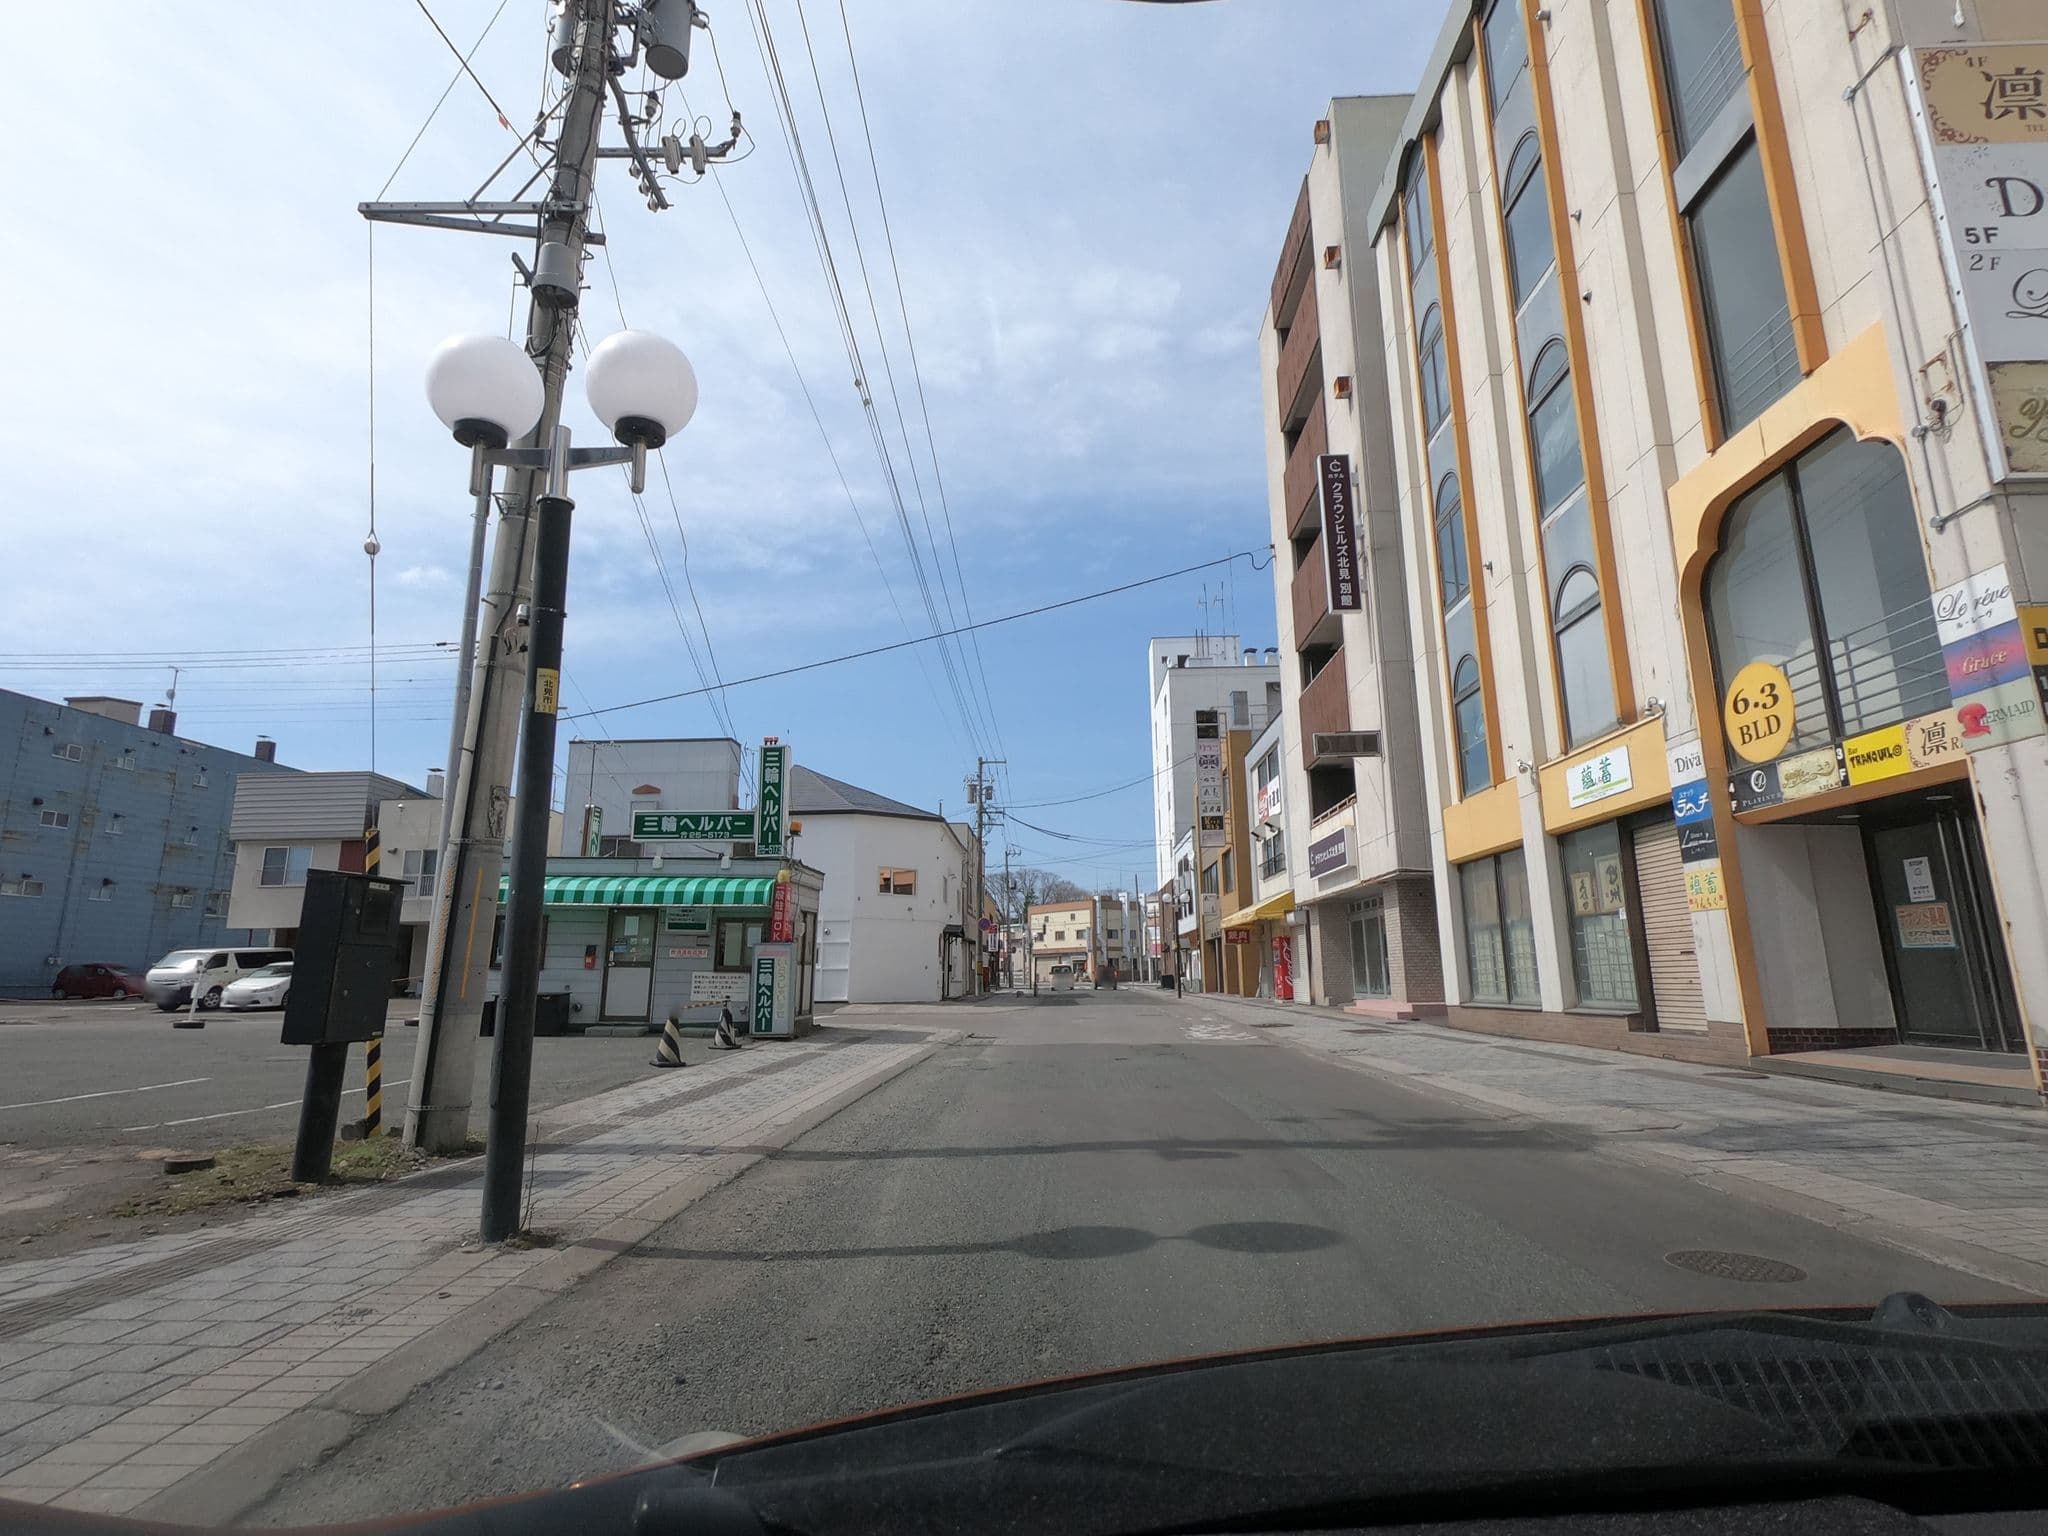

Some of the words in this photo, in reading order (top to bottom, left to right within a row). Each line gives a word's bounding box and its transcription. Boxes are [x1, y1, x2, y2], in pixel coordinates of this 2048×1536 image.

[1979, 66, 2048, 121] 凛
[1965, 226, 2000, 244] 5F
[1969, 254, 2001, 272] 2F
[1331, 482, 1351, 580] クラウンヒルズ北見
[1732, 682, 1780, 715] 6.3
[1738, 714, 1782, 746] BLD
[1920, 721, 1947, 757] 凛
[1674, 755, 1702, 774] Diva
[763, 750, 781, 845] 三輪ヘルパー
[642, 815, 747, 833] 三輪ヘルパー
[757, 959, 773, 1032] 三輪ヘルパー
